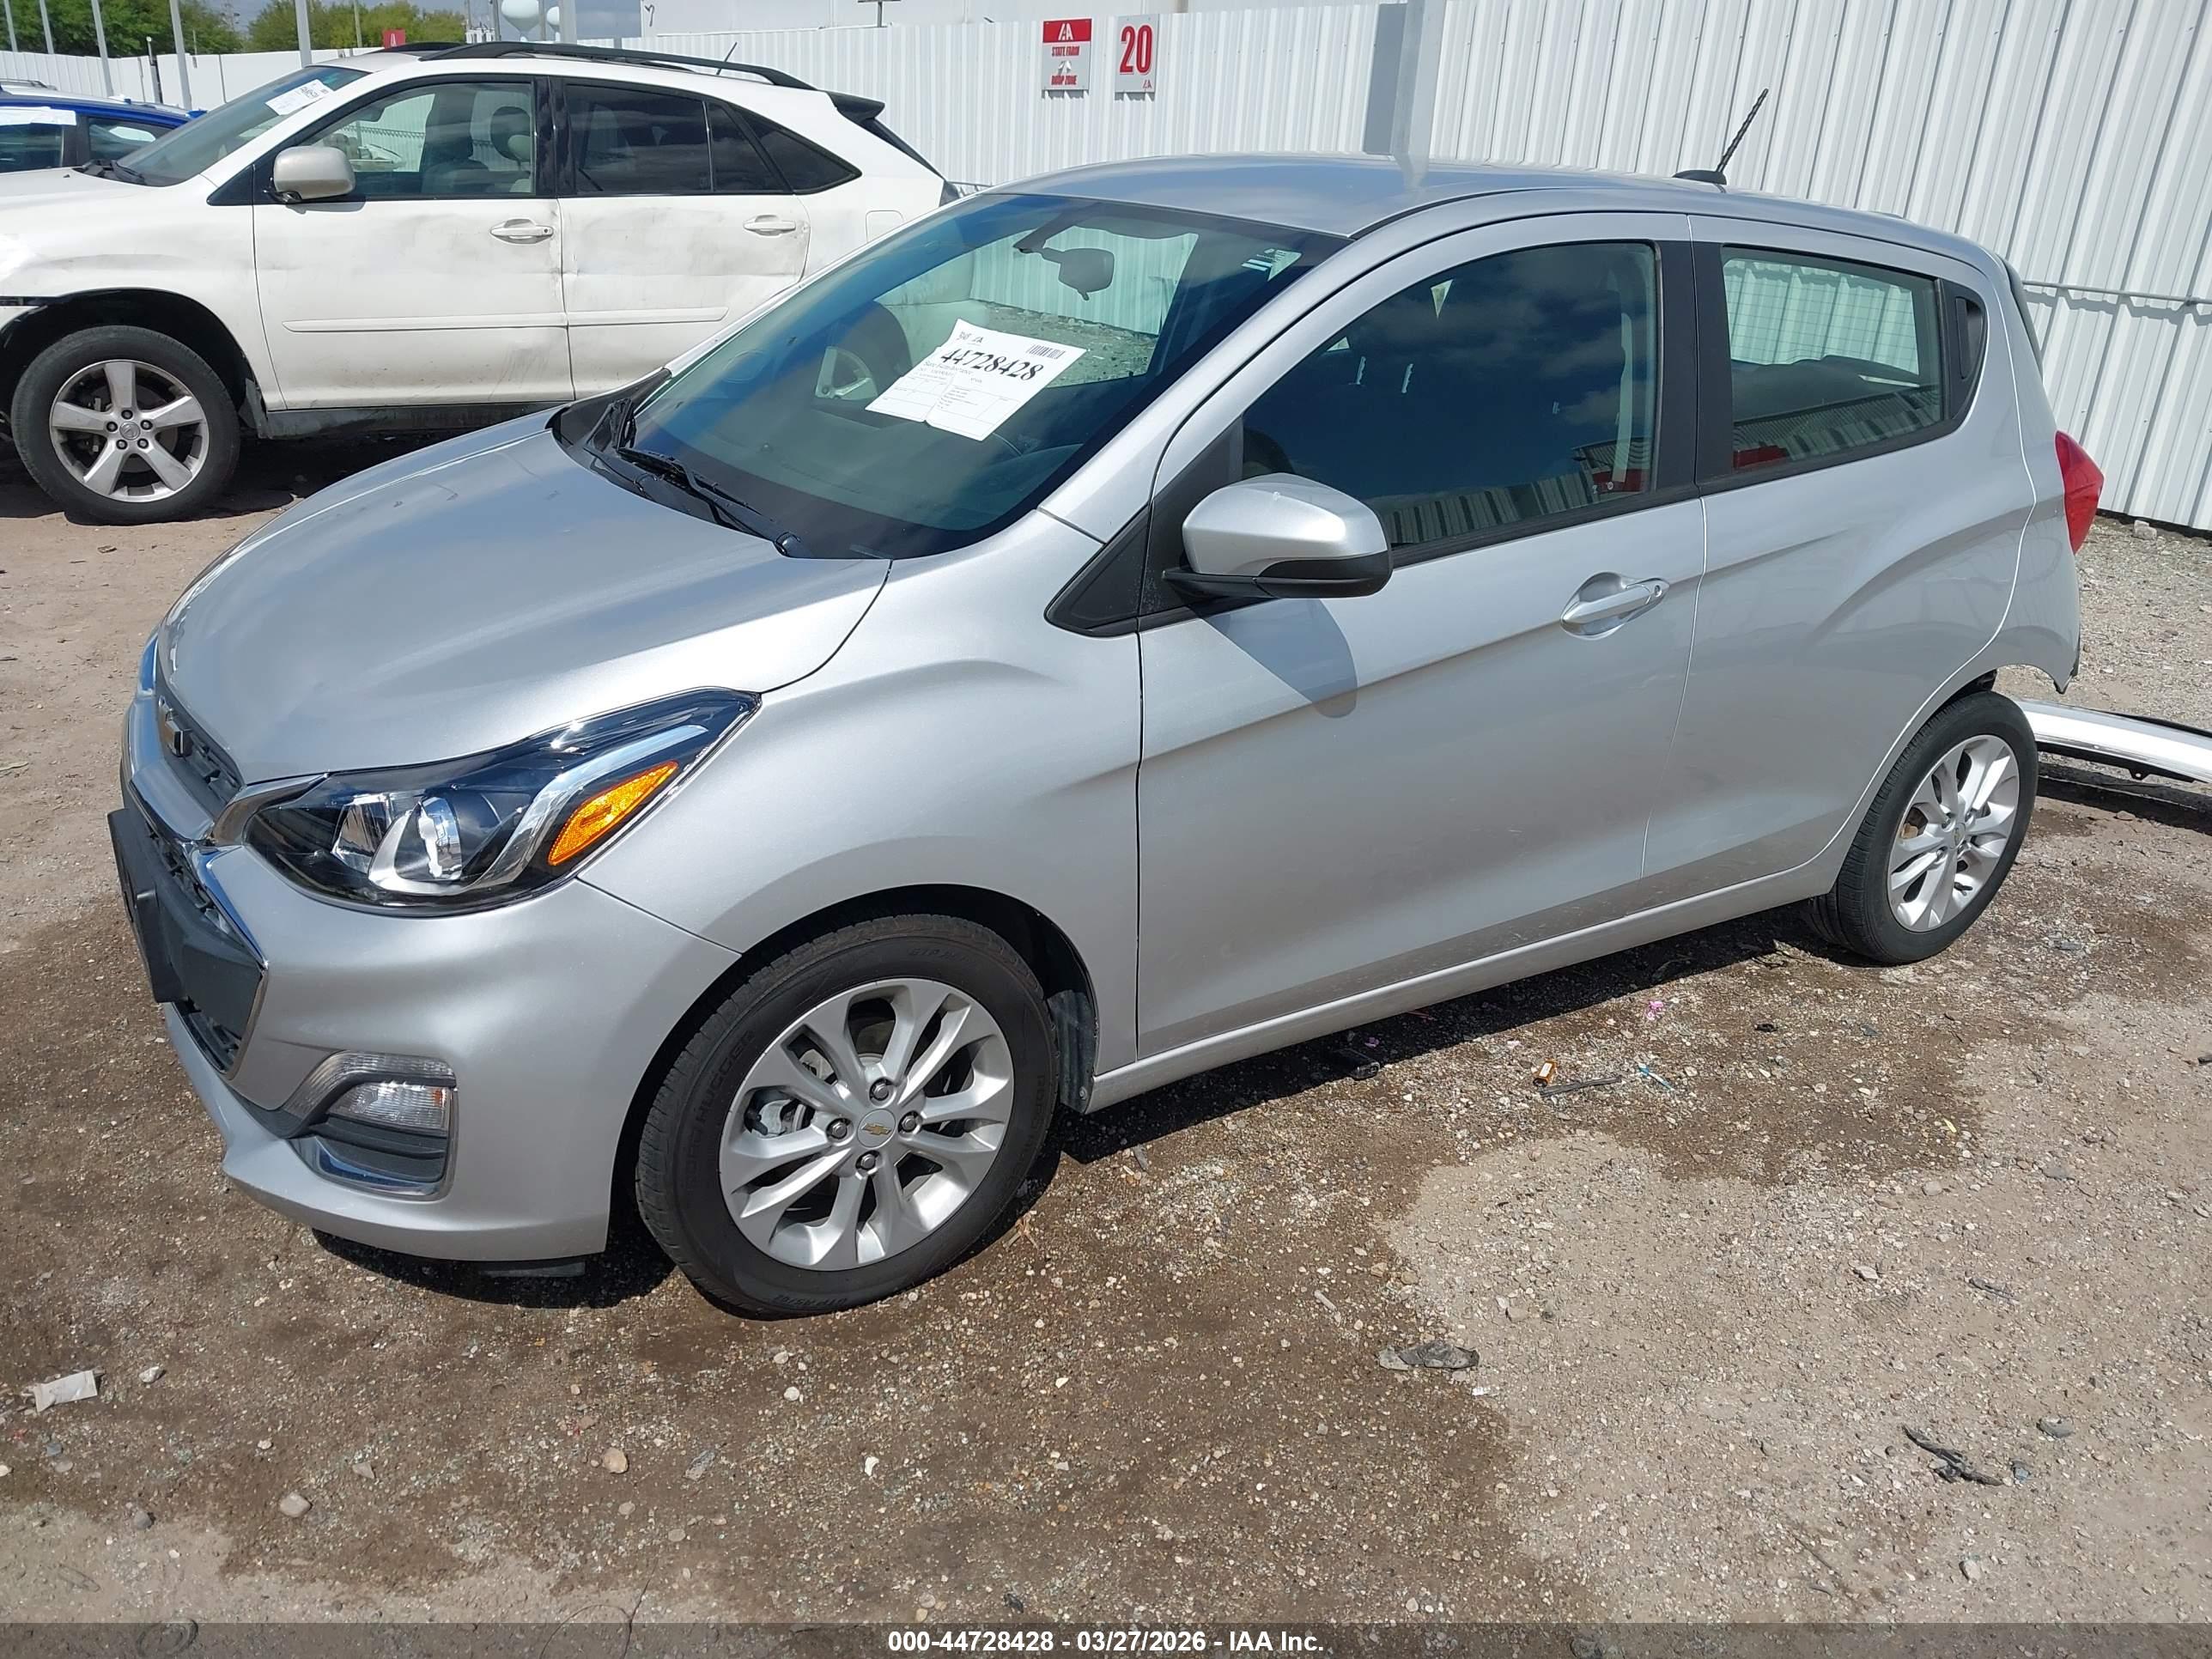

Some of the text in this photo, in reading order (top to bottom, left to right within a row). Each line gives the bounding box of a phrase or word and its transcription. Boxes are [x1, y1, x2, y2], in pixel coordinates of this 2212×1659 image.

[1051, 46, 1080, 57] STATE FARM
[1120, 25, 1153, 74] 20
[1050, 75, 1078, 86] DROP ZONE
[940, 348, 1044, 381] 44728428
